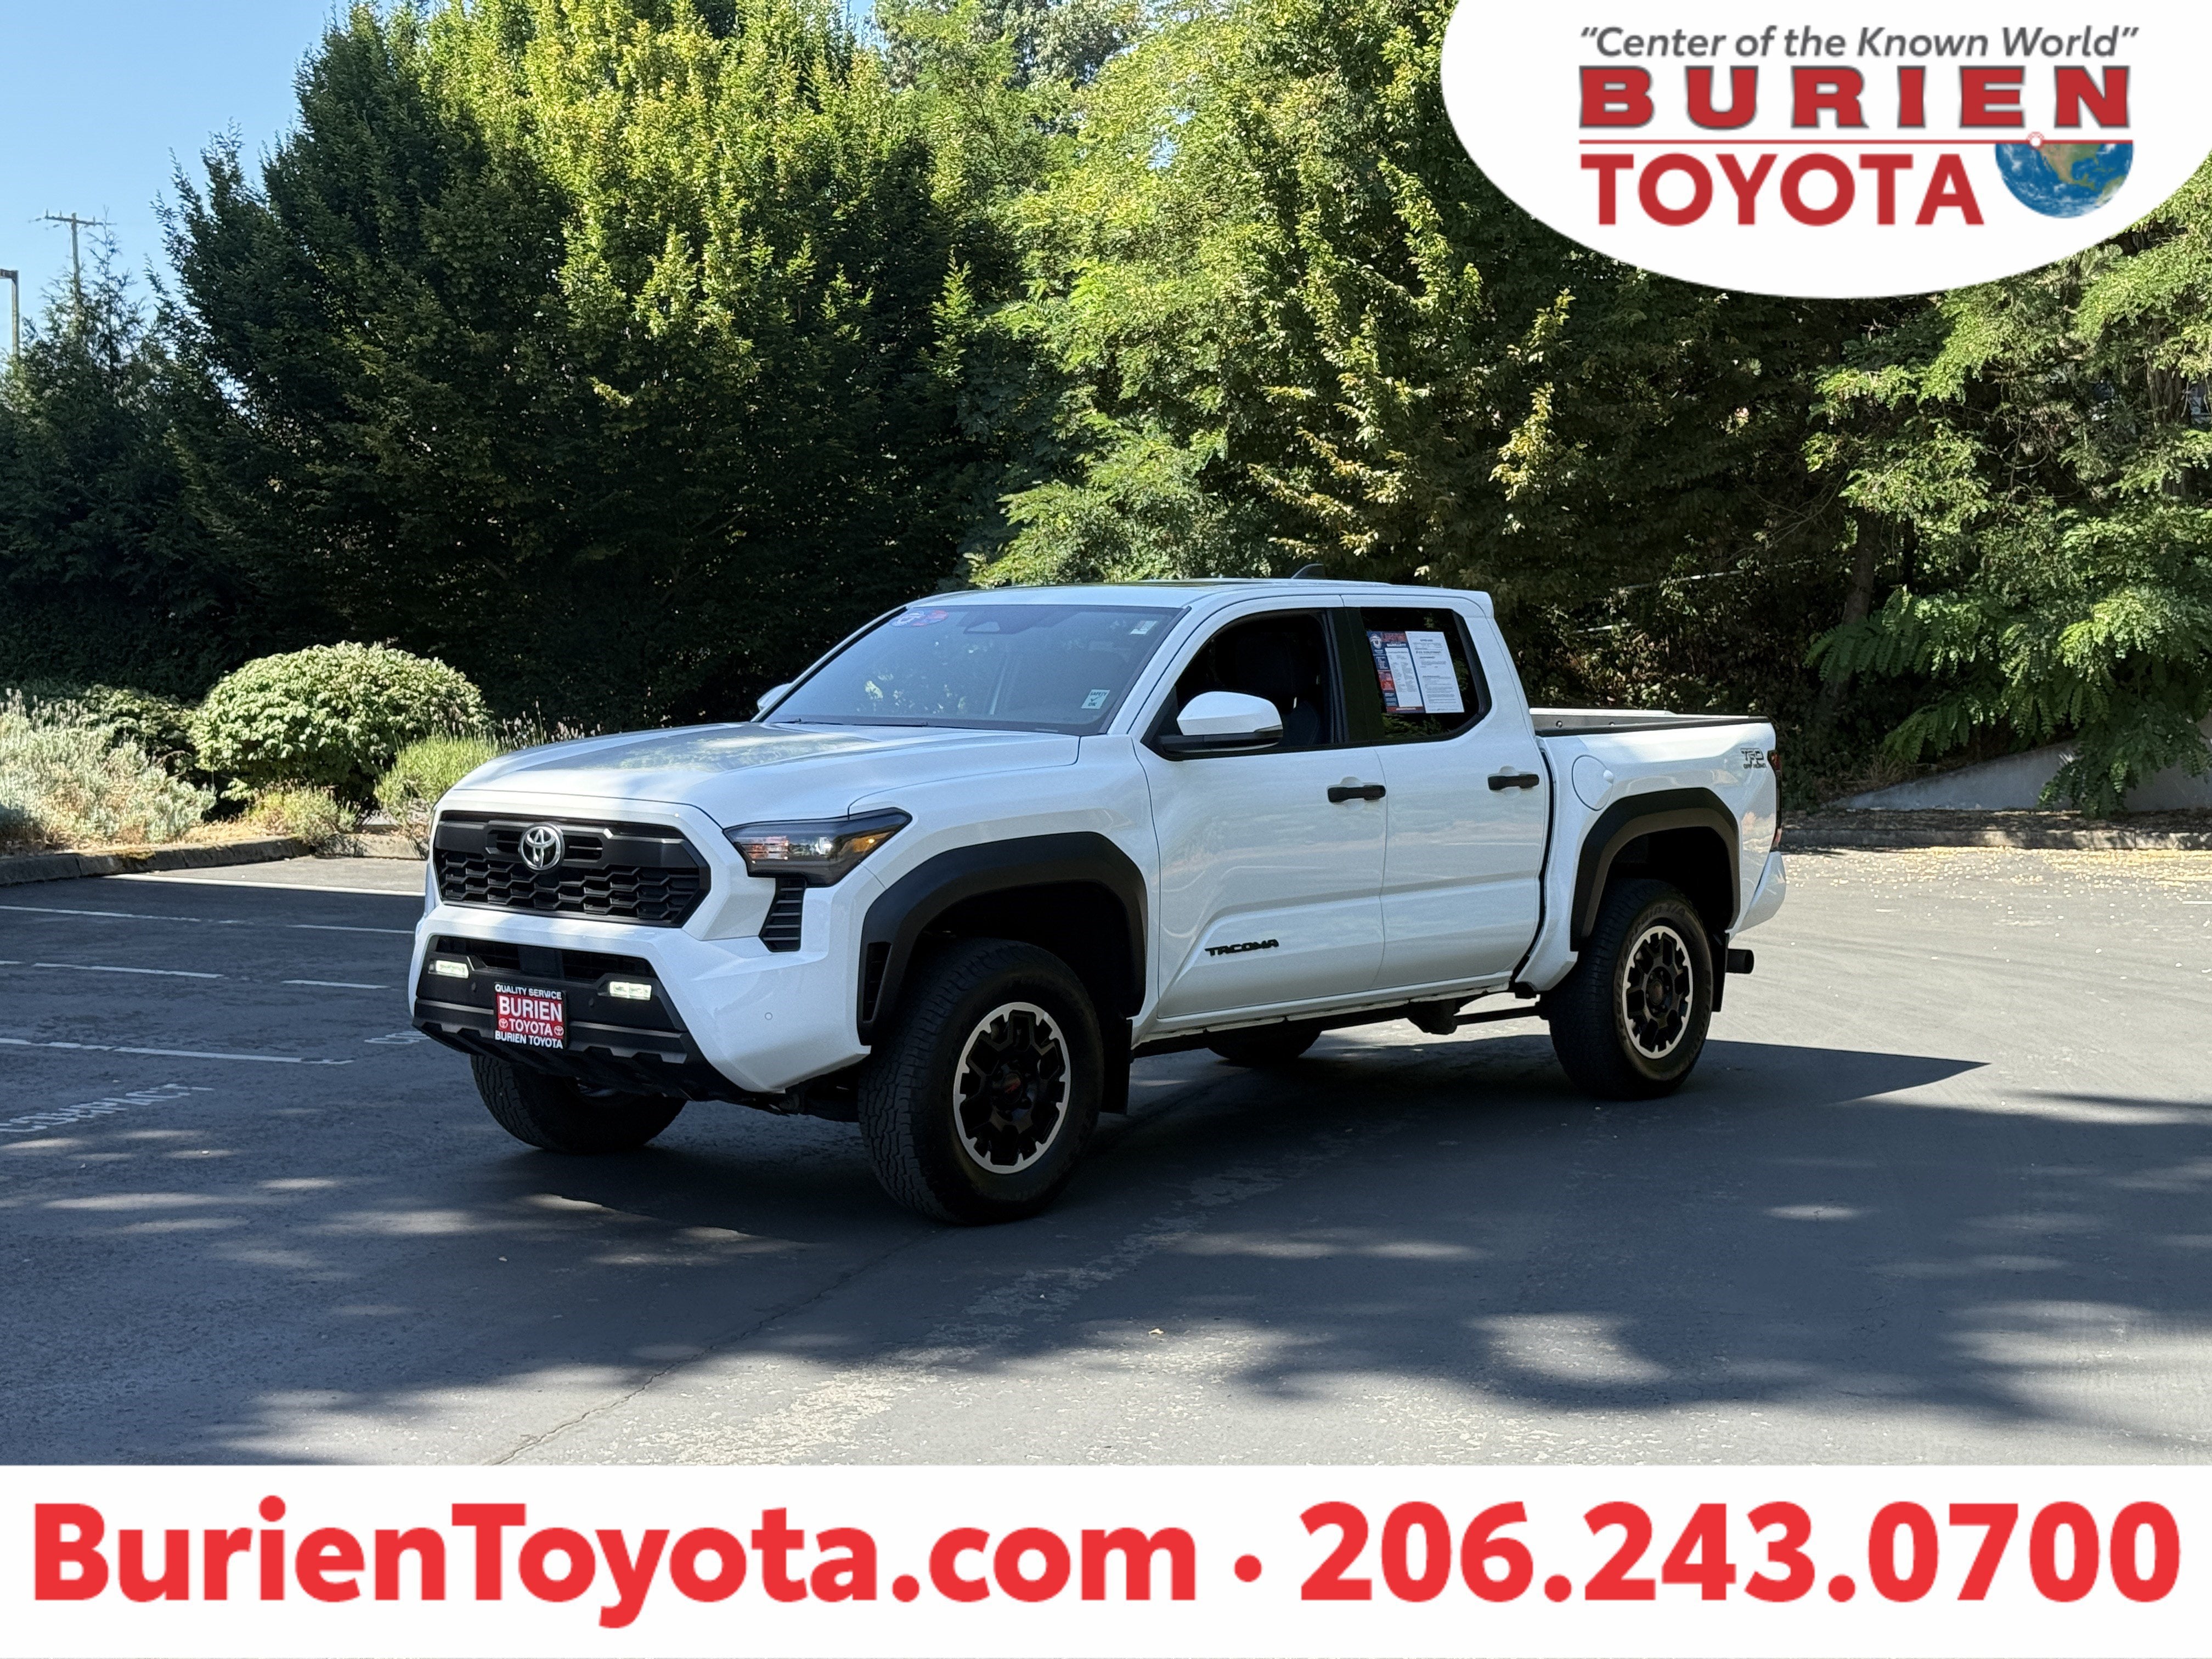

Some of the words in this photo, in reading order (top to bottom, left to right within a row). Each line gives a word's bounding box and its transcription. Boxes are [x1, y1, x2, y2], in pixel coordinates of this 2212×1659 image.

[1204, 939, 1279, 957] TACOMA
[495, 984, 527, 996] QUALITY
[528, 988, 562, 1000] SERVICE
[498, 995, 563, 1022] BURIEN
[508, 1018, 553, 1036] TOYOTA
[495, 1030, 527, 1045] BURIEN
[528, 1035, 563, 1049] TOYOTA
